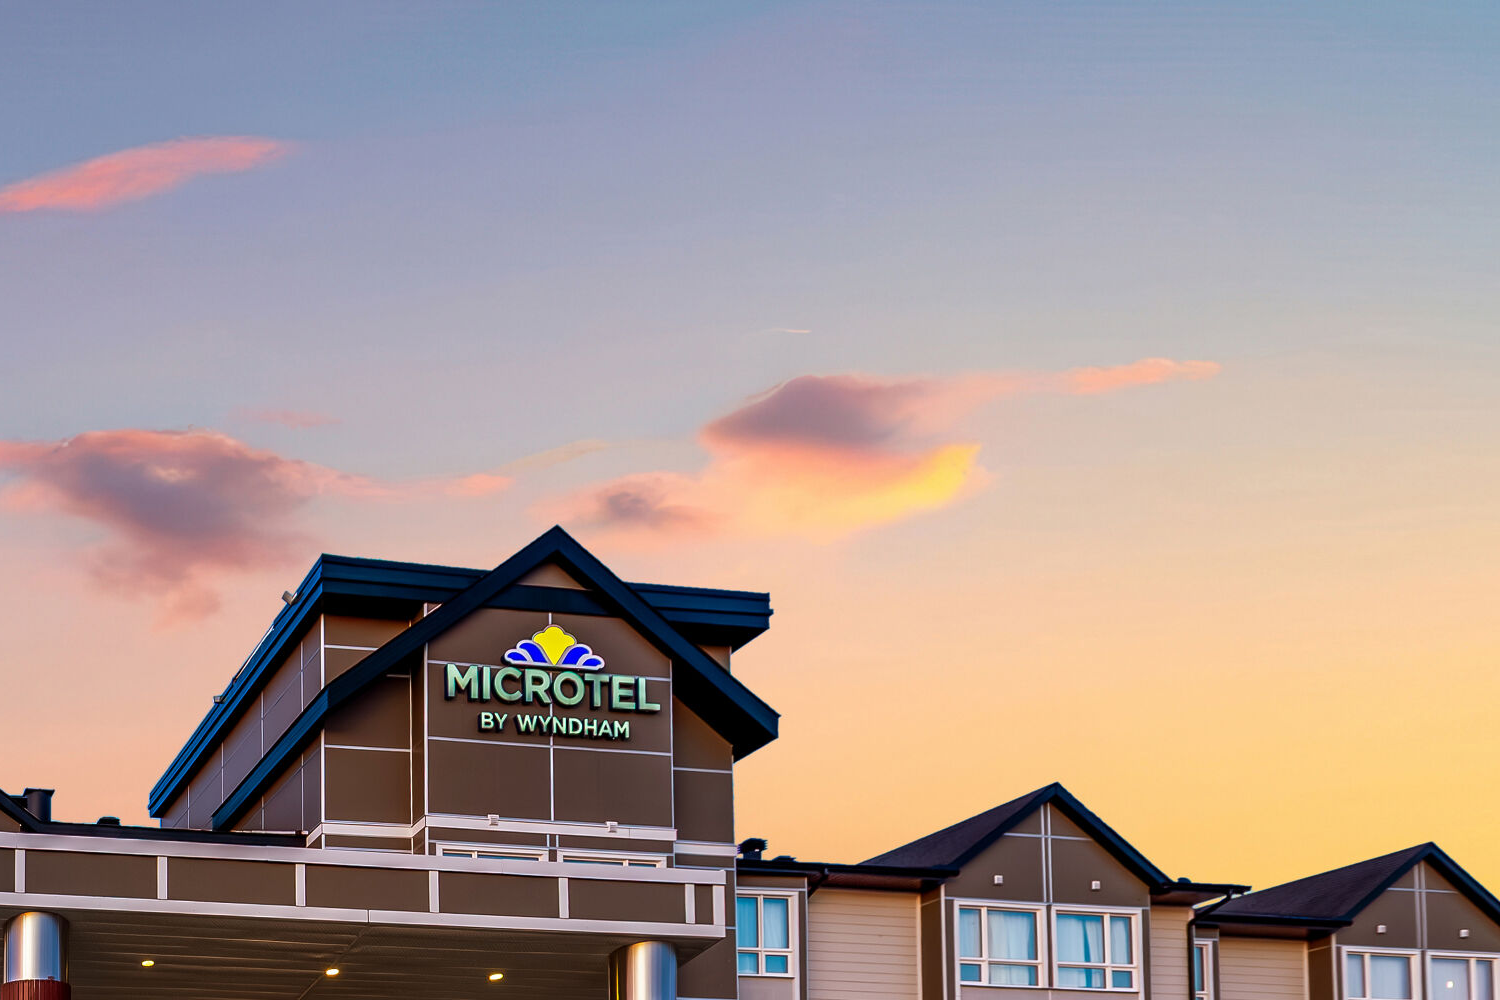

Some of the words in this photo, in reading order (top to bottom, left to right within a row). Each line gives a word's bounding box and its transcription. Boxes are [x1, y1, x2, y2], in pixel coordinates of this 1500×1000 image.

[446, 664, 661, 711] MICROTEL
[481, 712, 507, 730] BY
[516, 714, 631, 738] WYNDHAM
